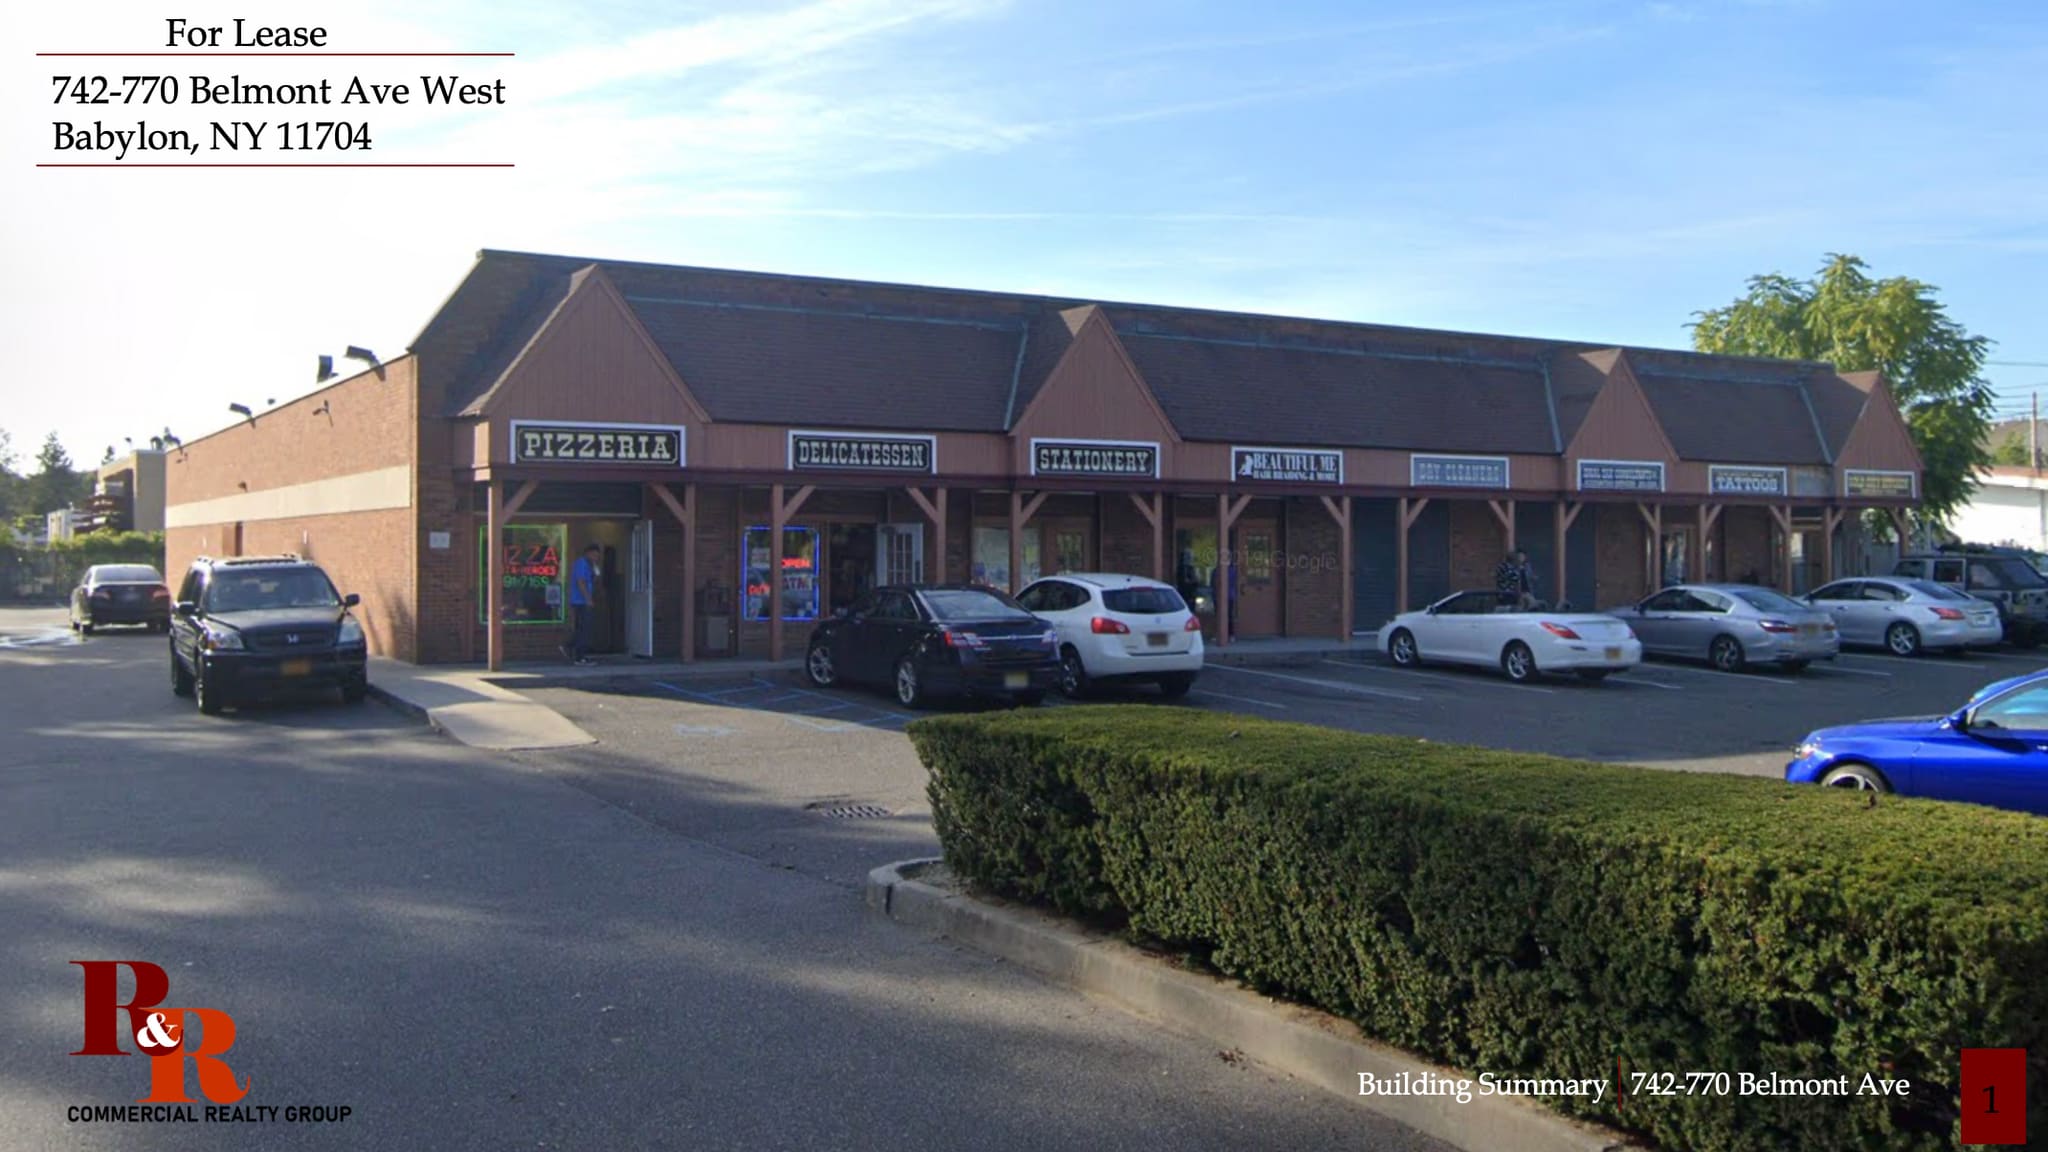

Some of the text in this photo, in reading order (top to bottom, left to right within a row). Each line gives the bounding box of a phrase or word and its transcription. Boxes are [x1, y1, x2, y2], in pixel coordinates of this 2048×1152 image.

[523, 431, 672, 460] PIZZERIA
[799, 439, 924, 467] DELICATESSEN
[1039, 448, 1149, 472] STATIONERY
[1253, 453, 1337, 472] BEAUTIFUL ME
[503, 545, 559, 566] IZZA
